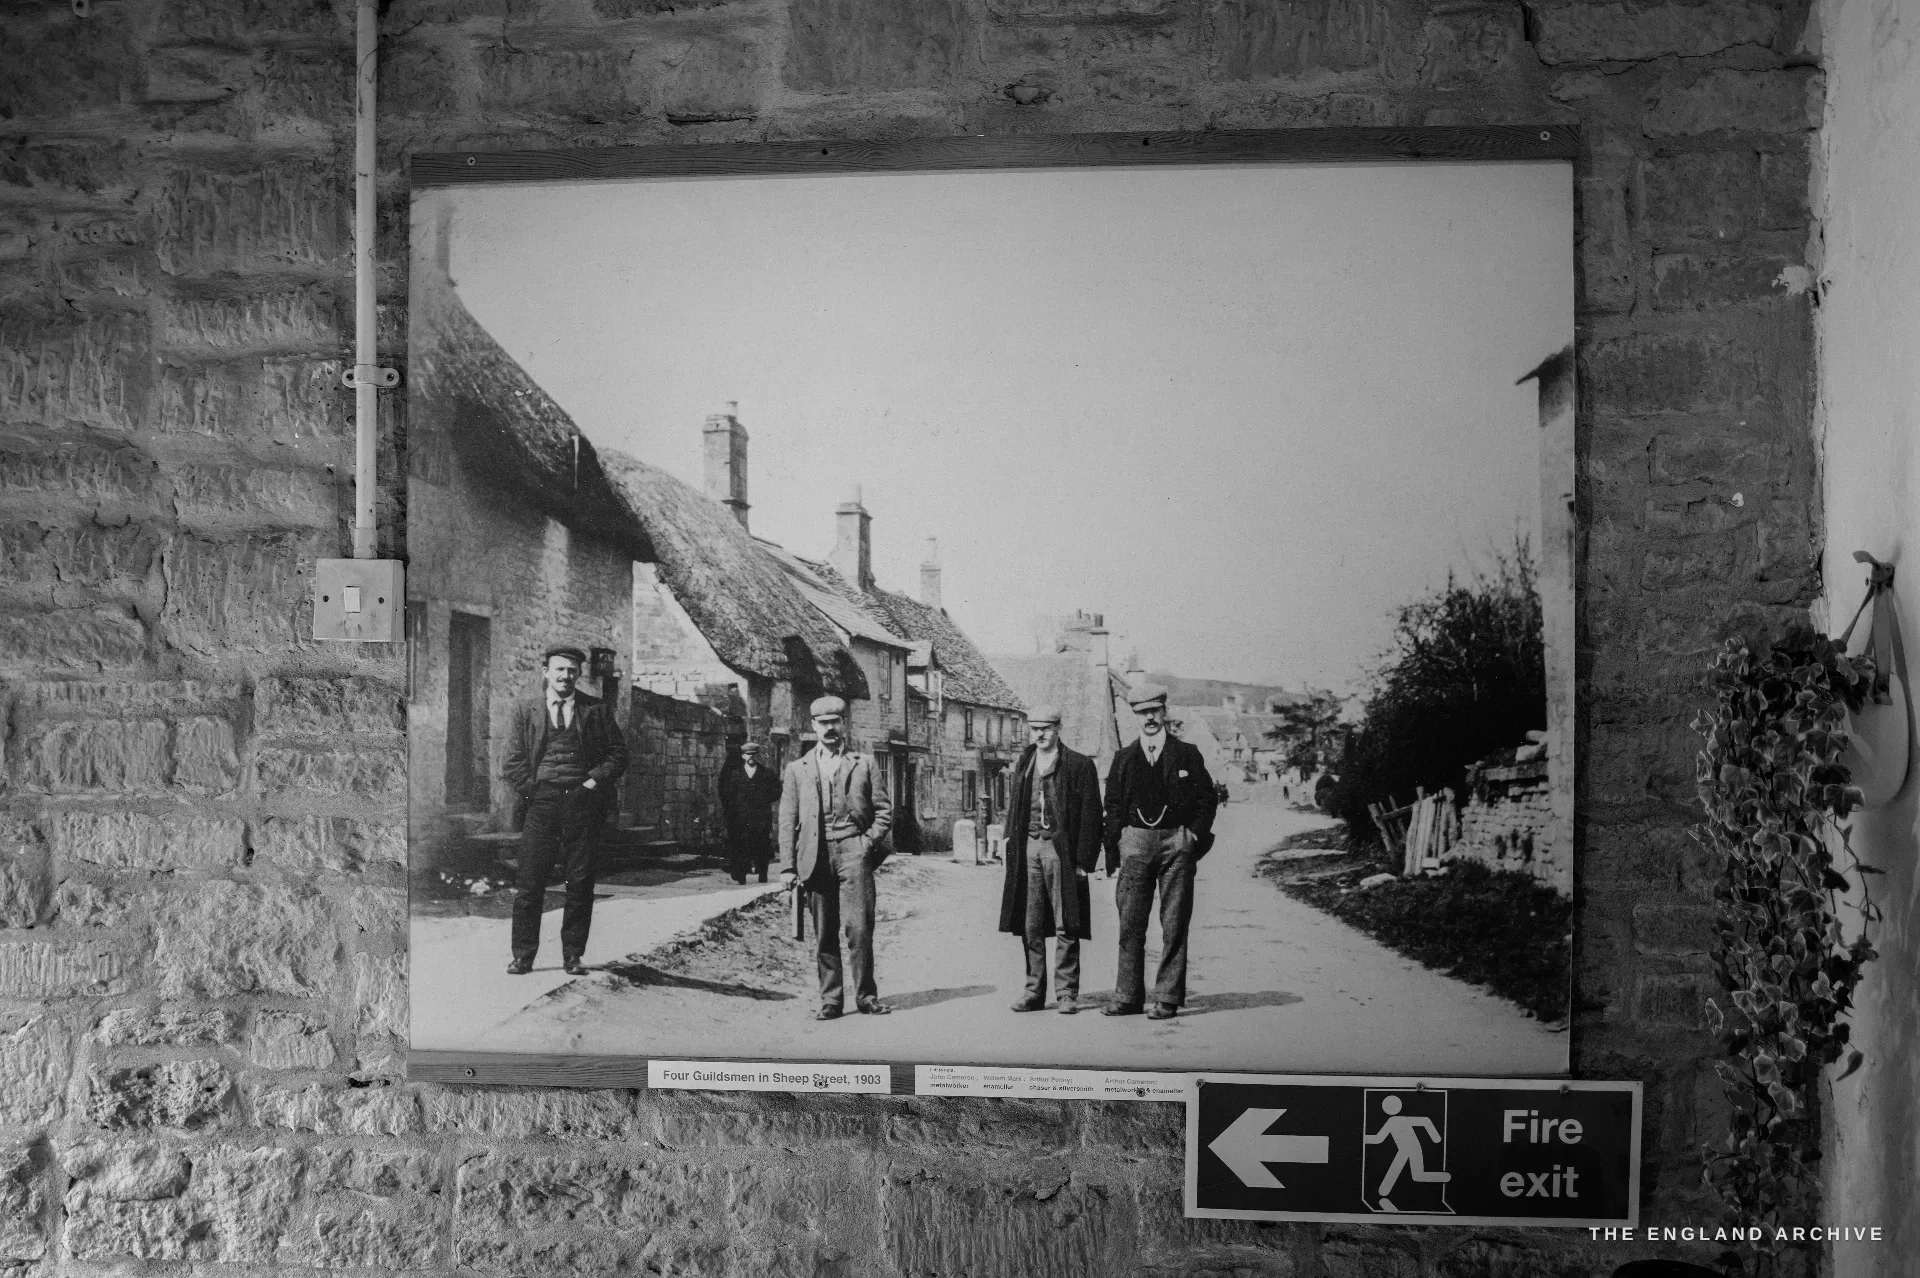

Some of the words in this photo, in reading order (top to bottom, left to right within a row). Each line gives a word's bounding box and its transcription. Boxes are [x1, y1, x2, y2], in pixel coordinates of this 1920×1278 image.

[663, 1070, 690, 1081] Four
[693, 1070, 755, 1082] Guildsmen
[758, 1072, 769, 1083] in
[773, 1073, 809, 1085] Sheep
[812, 1073, 851, 1085] Street,
[854, 1074, 881, 1085] 1903
[1502, 1109, 1584, 1145] Fire
[1500, 1164, 1580, 1199] exit
